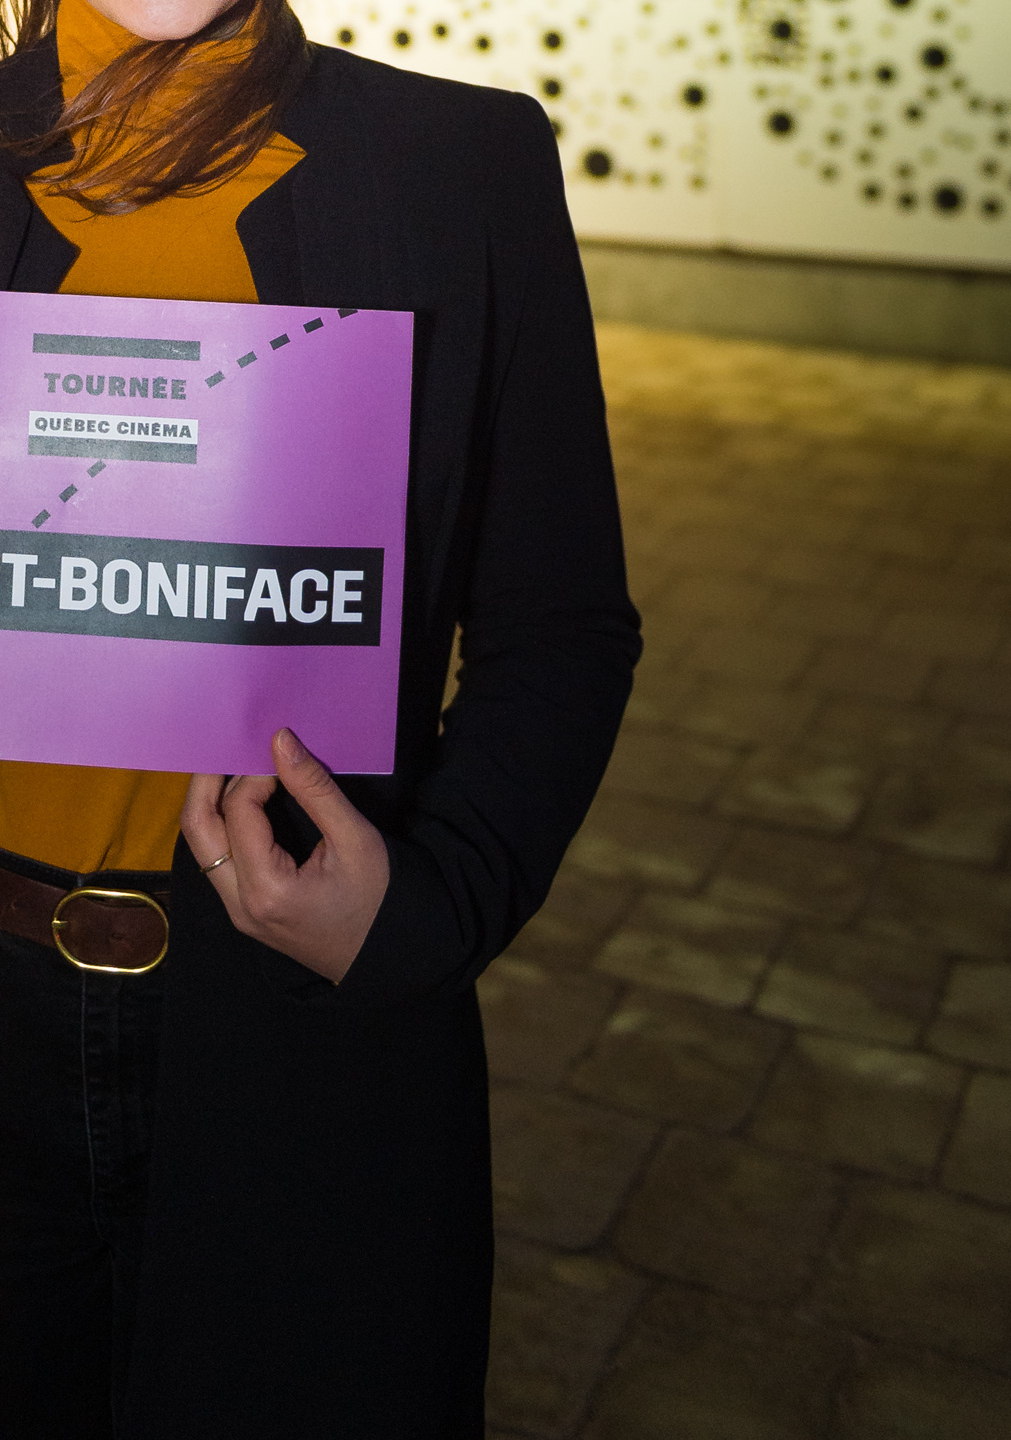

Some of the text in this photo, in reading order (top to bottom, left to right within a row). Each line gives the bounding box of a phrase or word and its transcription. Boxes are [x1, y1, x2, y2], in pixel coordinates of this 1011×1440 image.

[43, 372, 187, 400] TOURNÉE
[34, 416, 192, 439] QUÉBEC CINÉMA
